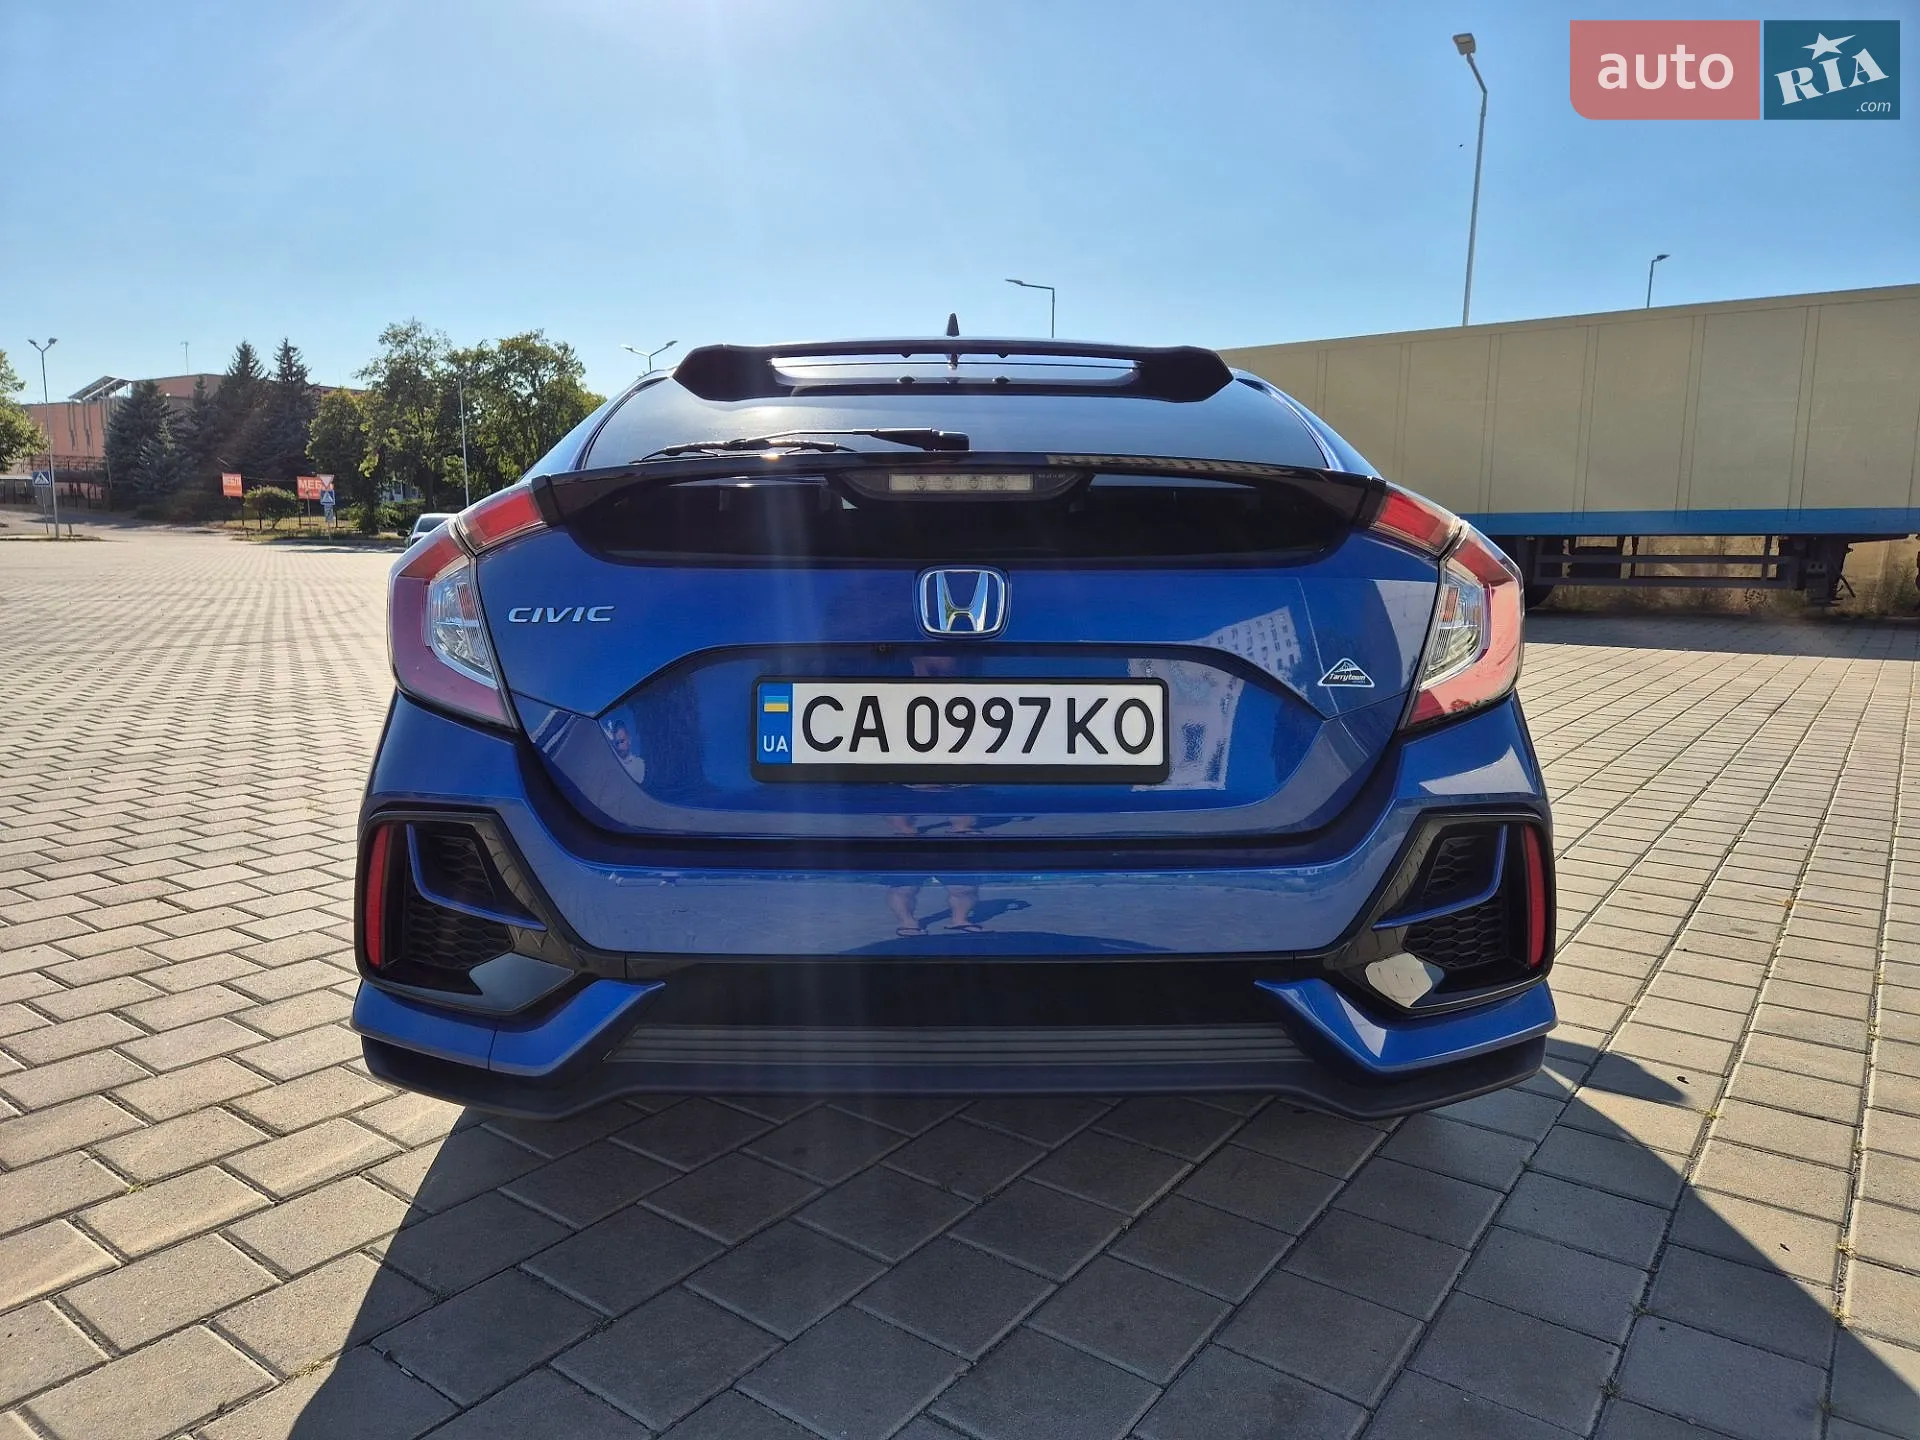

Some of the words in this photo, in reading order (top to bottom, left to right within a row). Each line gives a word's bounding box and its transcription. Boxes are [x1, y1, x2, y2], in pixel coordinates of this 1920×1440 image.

[508, 605, 615, 623] CIVIC
[802, 695, 890, 753] CA
[906, 696, 1052, 754] 0997
[1066, 697, 1155, 755] KO
[763, 734, 789, 753] UA
